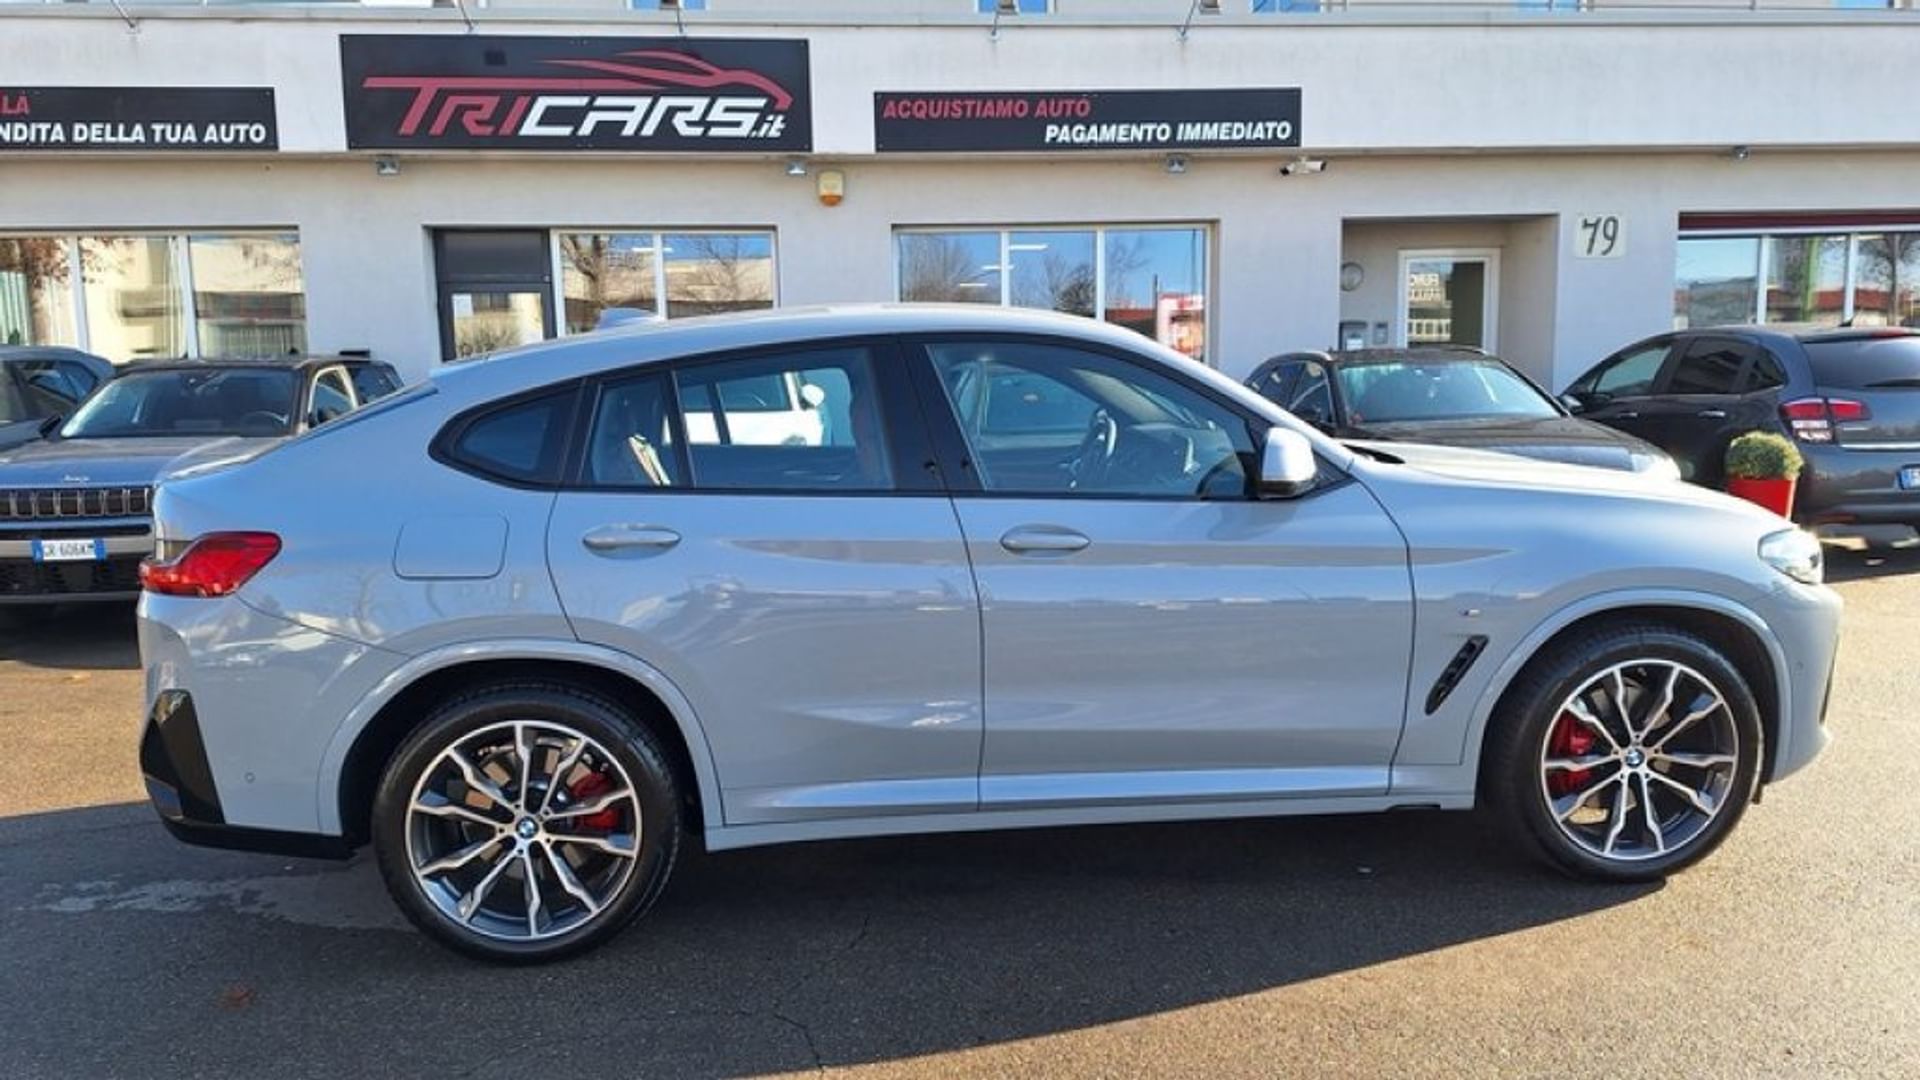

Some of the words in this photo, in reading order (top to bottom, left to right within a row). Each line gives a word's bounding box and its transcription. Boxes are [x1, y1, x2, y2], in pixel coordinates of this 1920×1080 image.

[883, 99, 1029, 119] ACQUISTIAMO
[1035, 99, 1091, 118] AUTO
[72, 122, 146, 143] DELLA
[151, 122, 198, 143] TUA
[203, 122, 267, 143] AUTO
[1045, 122, 1171, 143] PAGAMENTO
[1176, 120, 1293, 141] IMMEDIATO
[1582, 216, 1619, 256] 79
